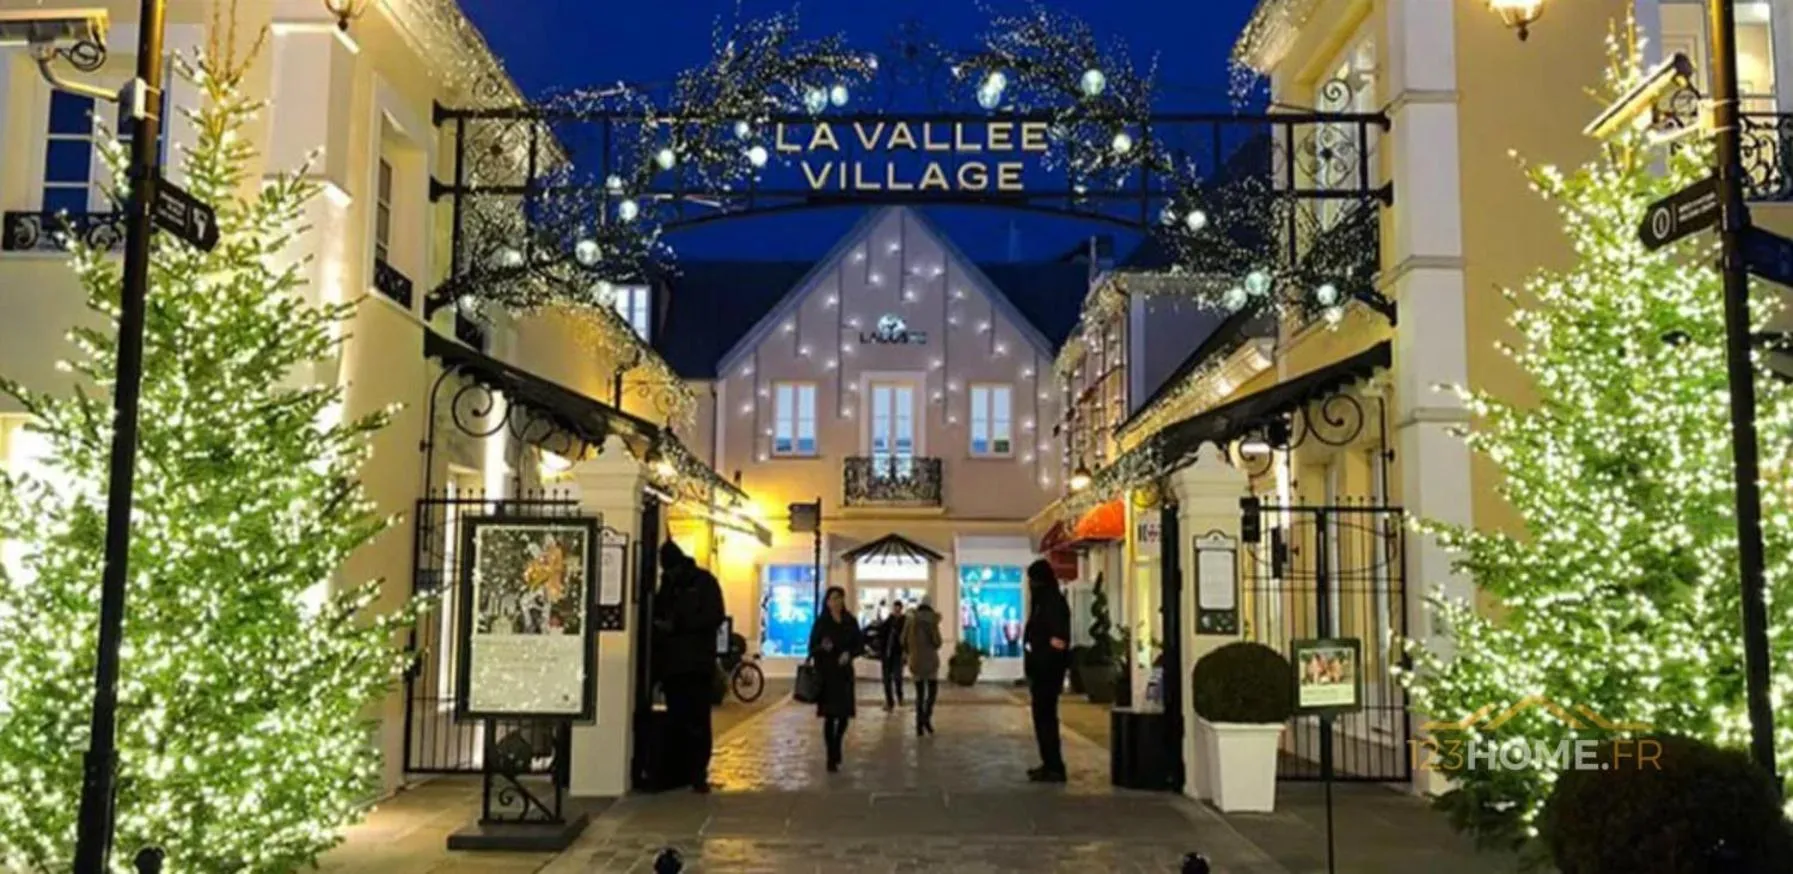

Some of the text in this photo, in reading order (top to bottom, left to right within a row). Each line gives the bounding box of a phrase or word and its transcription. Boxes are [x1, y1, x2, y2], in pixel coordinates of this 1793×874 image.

[776, 121, 1048, 150] LA VALLEE
[801, 161, 1024, 190] VILLAGE
